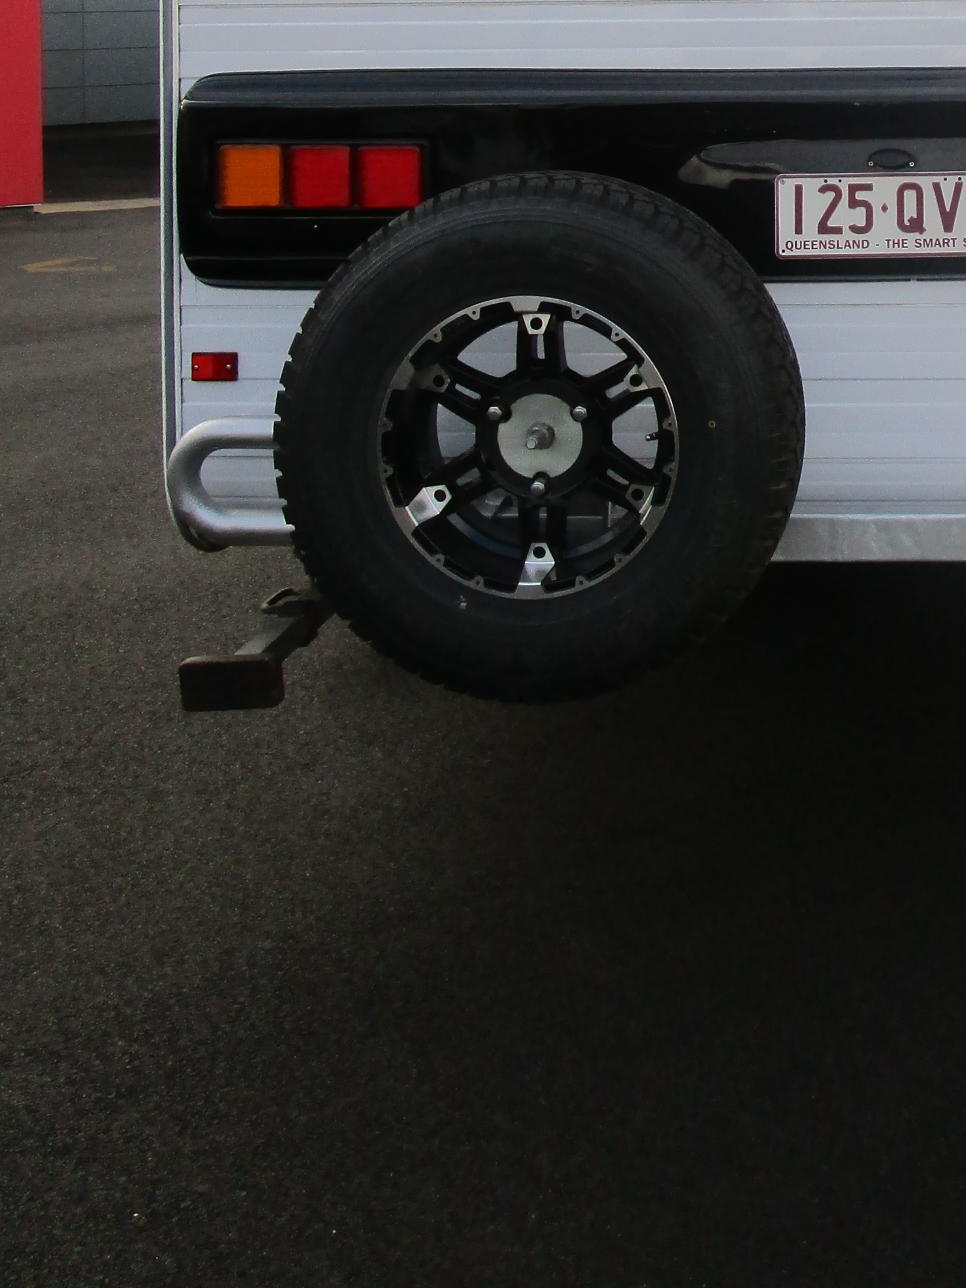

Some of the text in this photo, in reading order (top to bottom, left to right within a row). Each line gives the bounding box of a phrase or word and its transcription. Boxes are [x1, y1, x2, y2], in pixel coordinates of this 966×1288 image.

[785, 239, 870, 251] QUEENSLAND
[886, 238, 908, 249] THE
[914, 238, 958, 249] SMART
